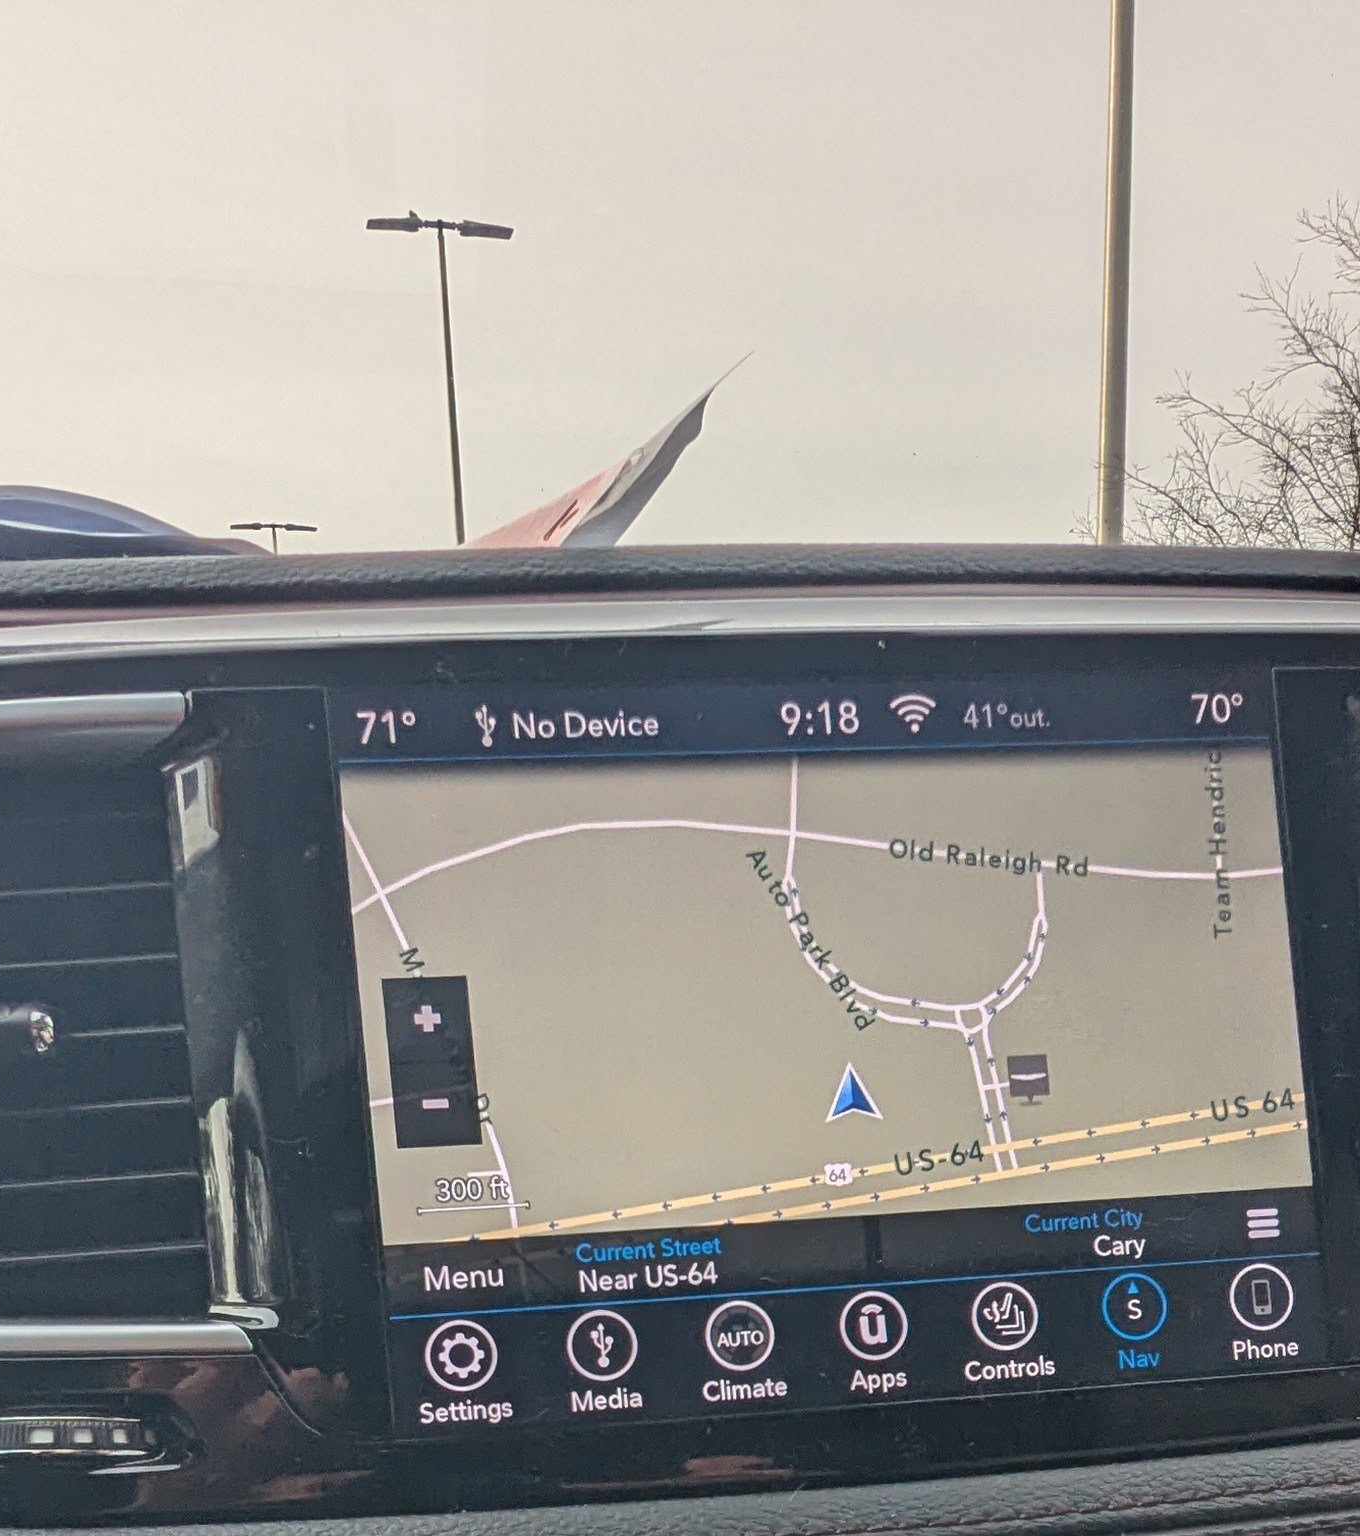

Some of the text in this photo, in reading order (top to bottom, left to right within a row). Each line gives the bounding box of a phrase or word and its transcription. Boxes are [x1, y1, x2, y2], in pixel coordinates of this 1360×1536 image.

[780, 701, 860, 736] 9:18
[1190, 693, 1244, 724] 70°
[356, 711, 416, 745] 71°
[512, 710, 660, 740] No Device
[1204, 741, 1232, 939] Team Hendric
[889, 838, 1089, 878] Old Raleigh Rd
[745, 850, 875, 1032] Auto Park Blvd
[893, 1140, 984, 1176] US-64
[436, 1175, 510, 1202] 300 ft
[828, 1168, 847, 1183] 64
[1024, 1207, 1144, 1233] Current City
[574, 1236, 722, 1264] Current Street
[1093, 1235, 1147, 1260] Cary
[423, 1265, 505, 1292] Menu
[577, 1262, 718, 1293] Near US-64
[1127, 1300, 1143, 1321] S
[717, 1329, 764, 1348] AUTO
[1232, 1339, 1300, 1361] Phone
[964, 1355, 1056, 1383] Controls
[1118, 1350, 1160, 1370] Nav
[702, 1378, 788, 1403] Climate
[850, 1368, 908, 1394] Apps
[419, 1398, 514, 1425] Settings
[570, 1387, 643, 1413] Media
